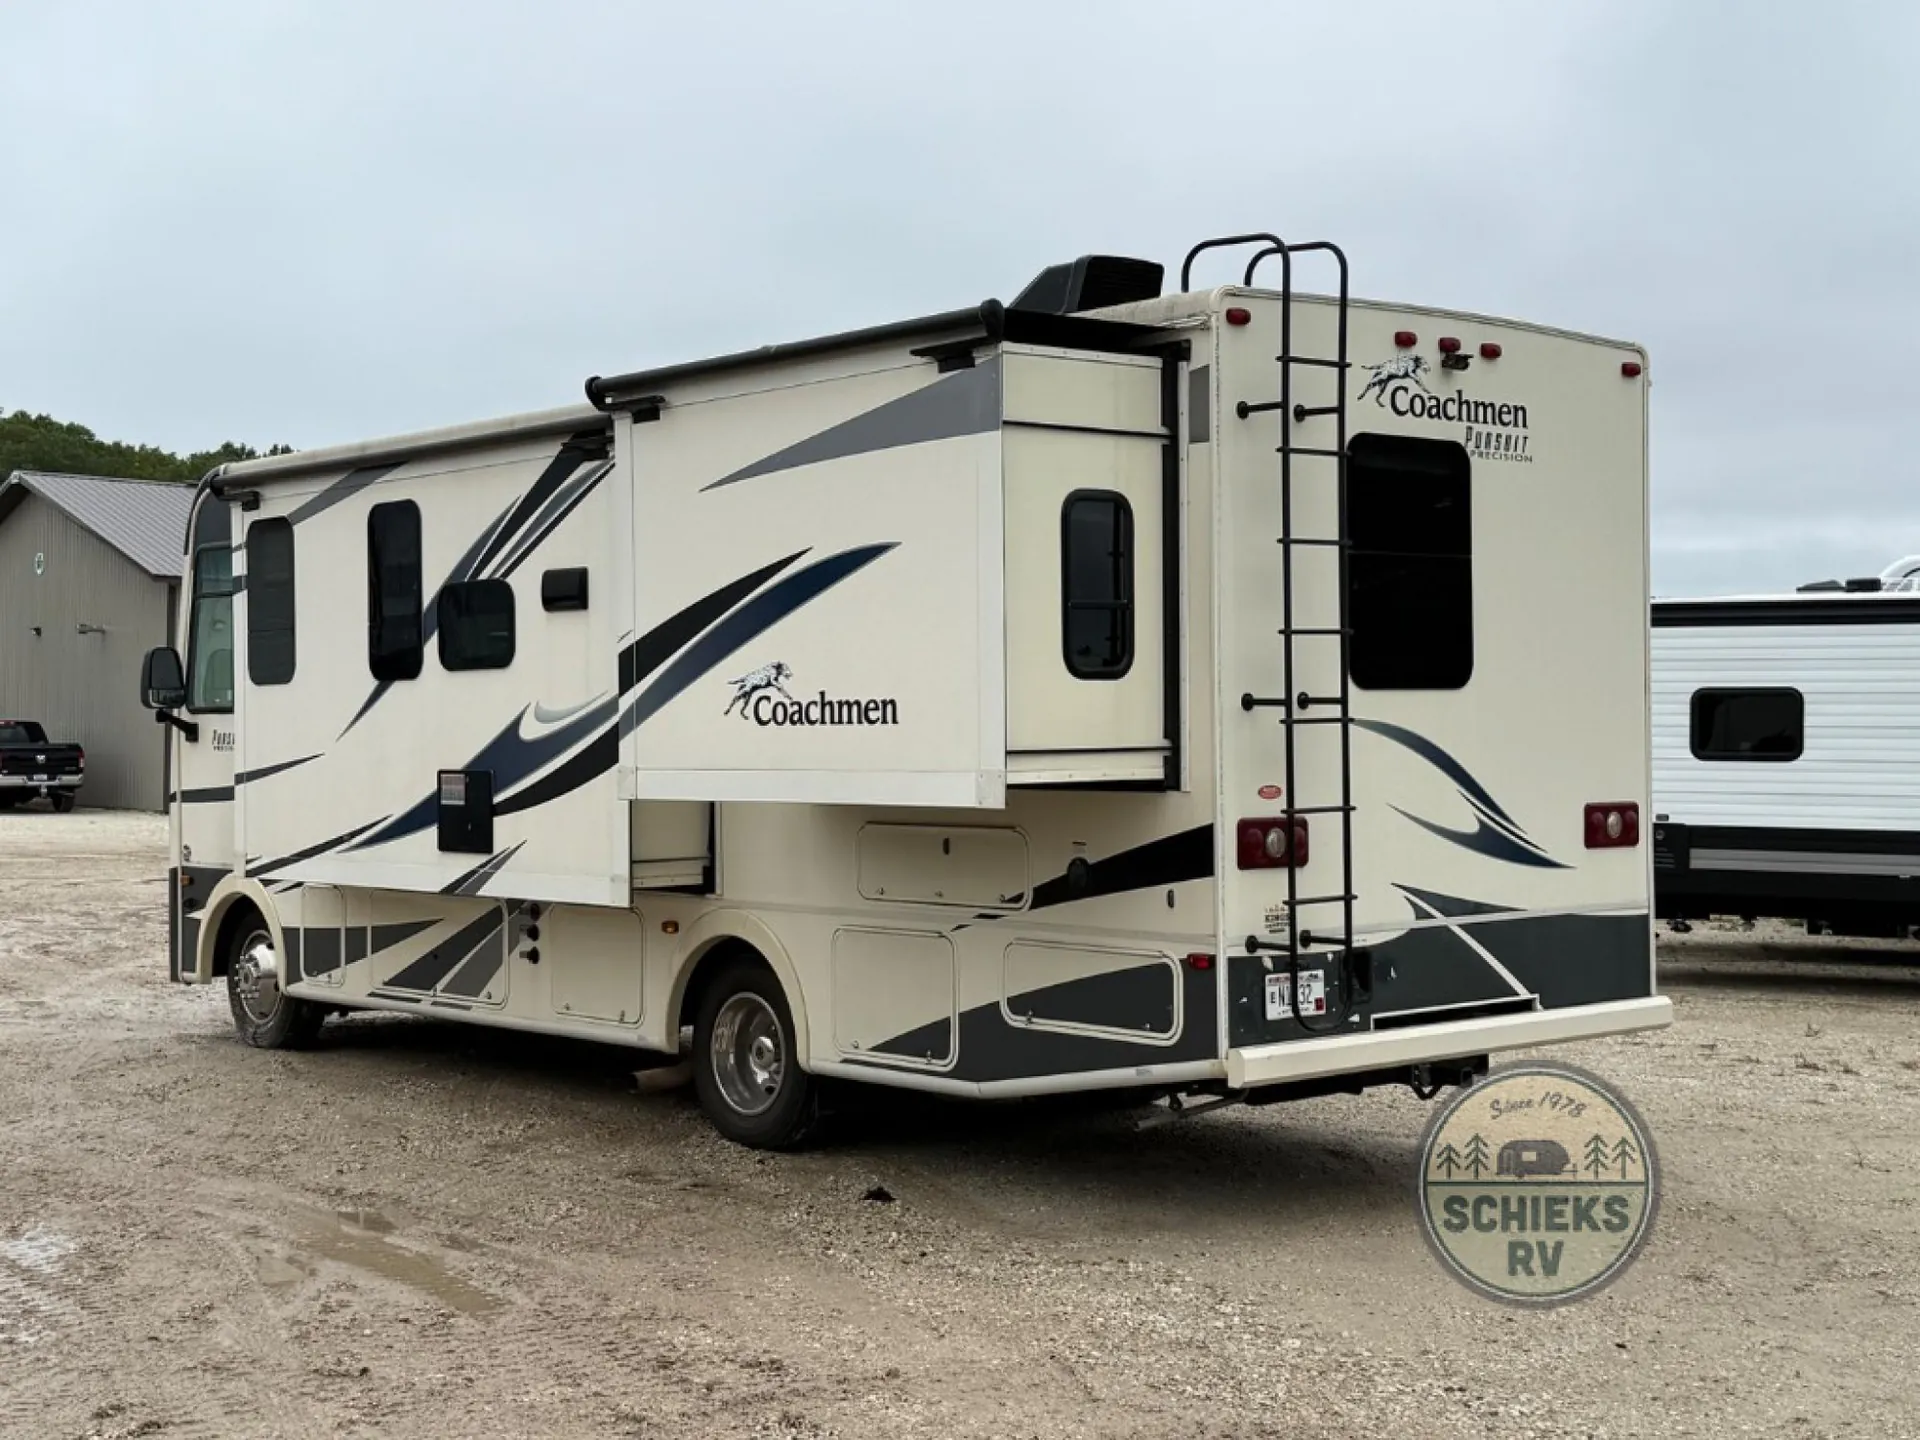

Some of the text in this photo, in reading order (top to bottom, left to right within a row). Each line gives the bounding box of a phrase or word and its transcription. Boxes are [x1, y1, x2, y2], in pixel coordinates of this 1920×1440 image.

[1390, 385, 1529, 429] Coachmen
[1469, 449, 1533, 464] PRECISION
[753, 689, 899, 727] Coachmen
